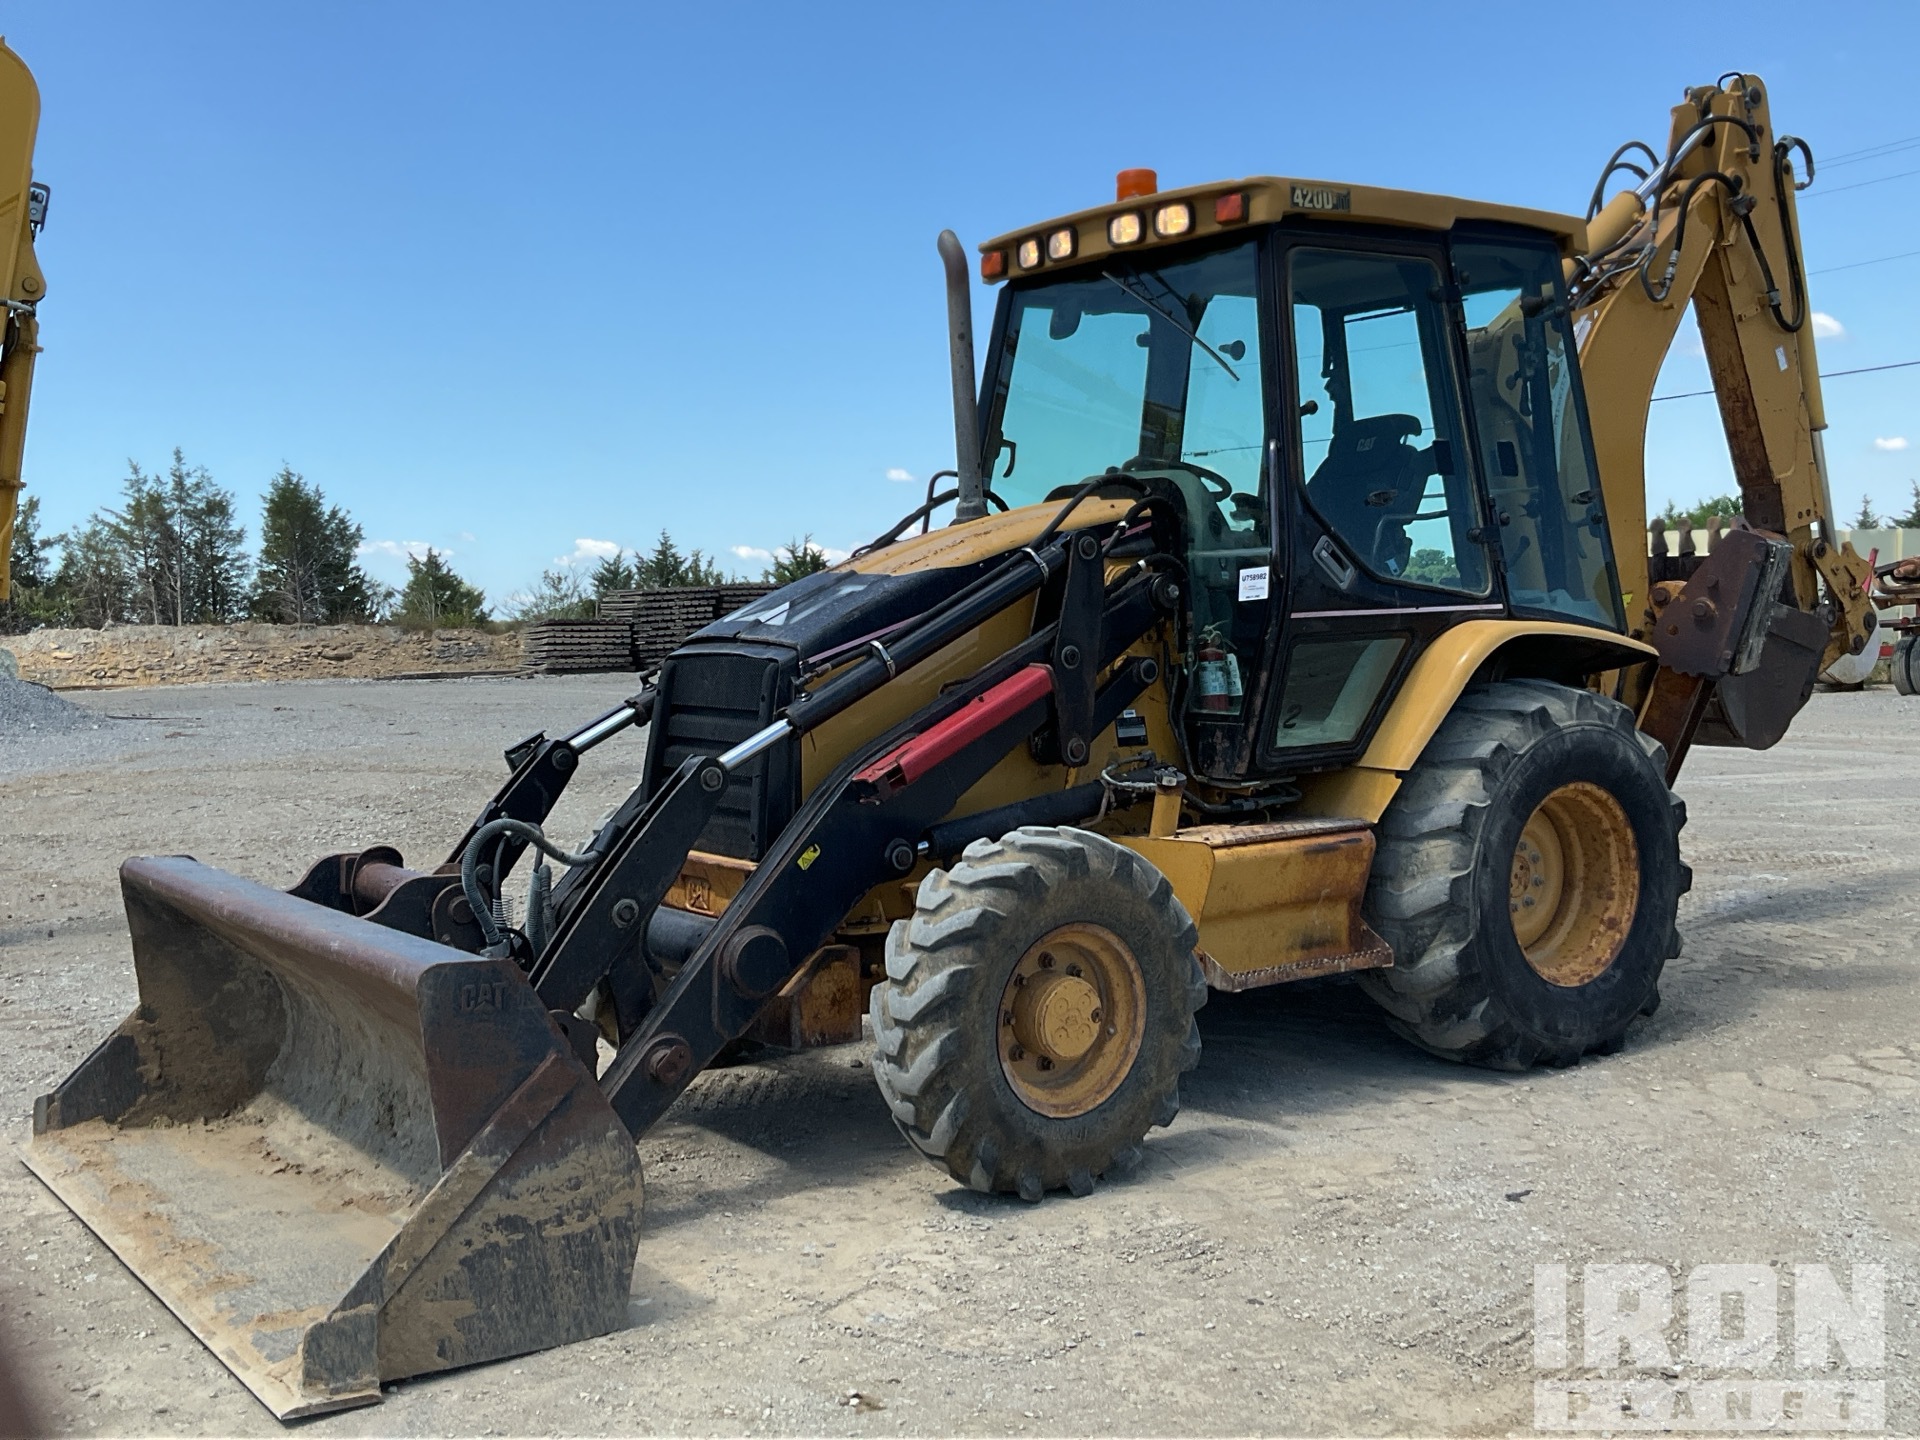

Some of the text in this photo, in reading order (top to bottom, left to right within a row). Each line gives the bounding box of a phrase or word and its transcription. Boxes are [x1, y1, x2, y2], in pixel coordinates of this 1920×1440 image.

[1293, 187, 1333, 210] 420D
[1356, 436, 1377, 451] CAT
[1241, 572, 1267, 582] U758982
[461, 982, 508, 1014] CAT
